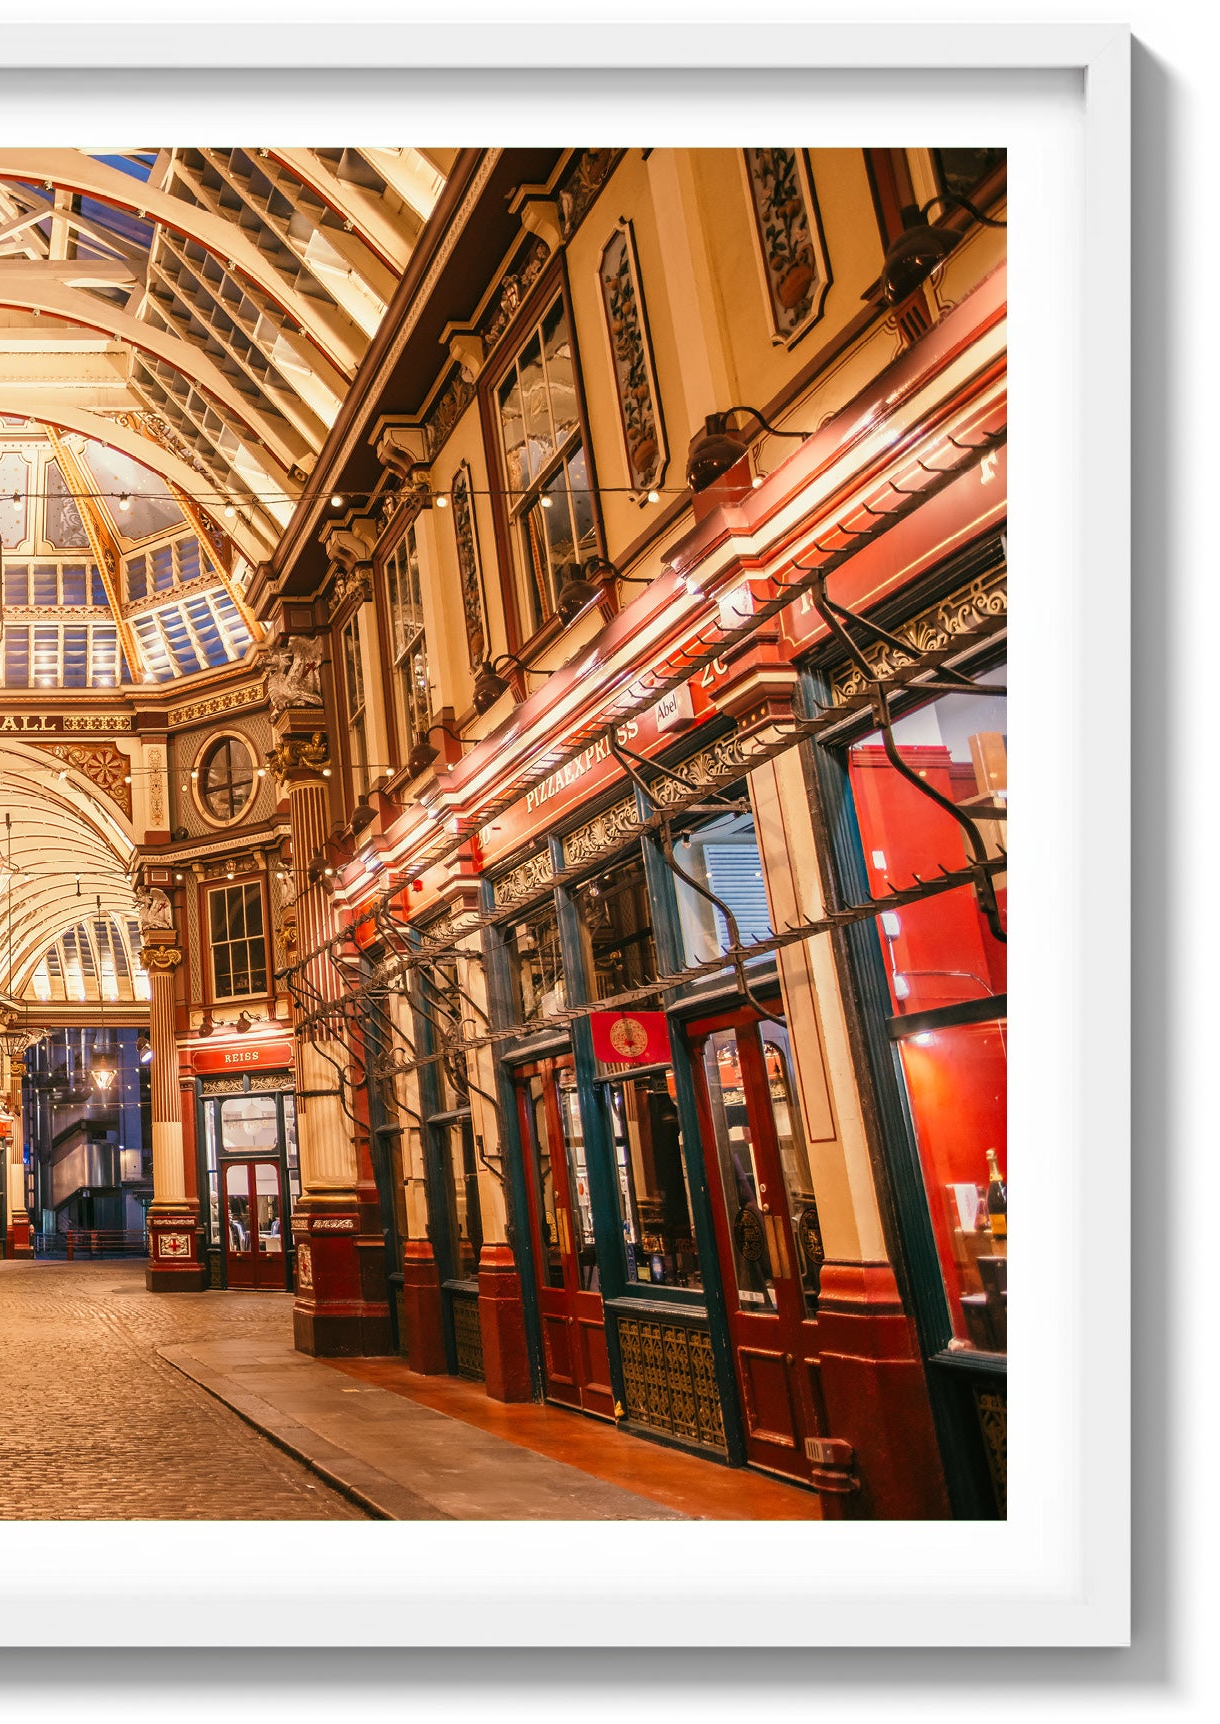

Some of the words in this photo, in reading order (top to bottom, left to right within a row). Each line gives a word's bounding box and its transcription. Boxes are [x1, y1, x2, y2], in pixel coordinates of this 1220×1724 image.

[657, 693, 678, 723] Abel
[526, 717, 638, 813] PIZZAEXPRSS
[225, 1052, 259, 1063] REISS
